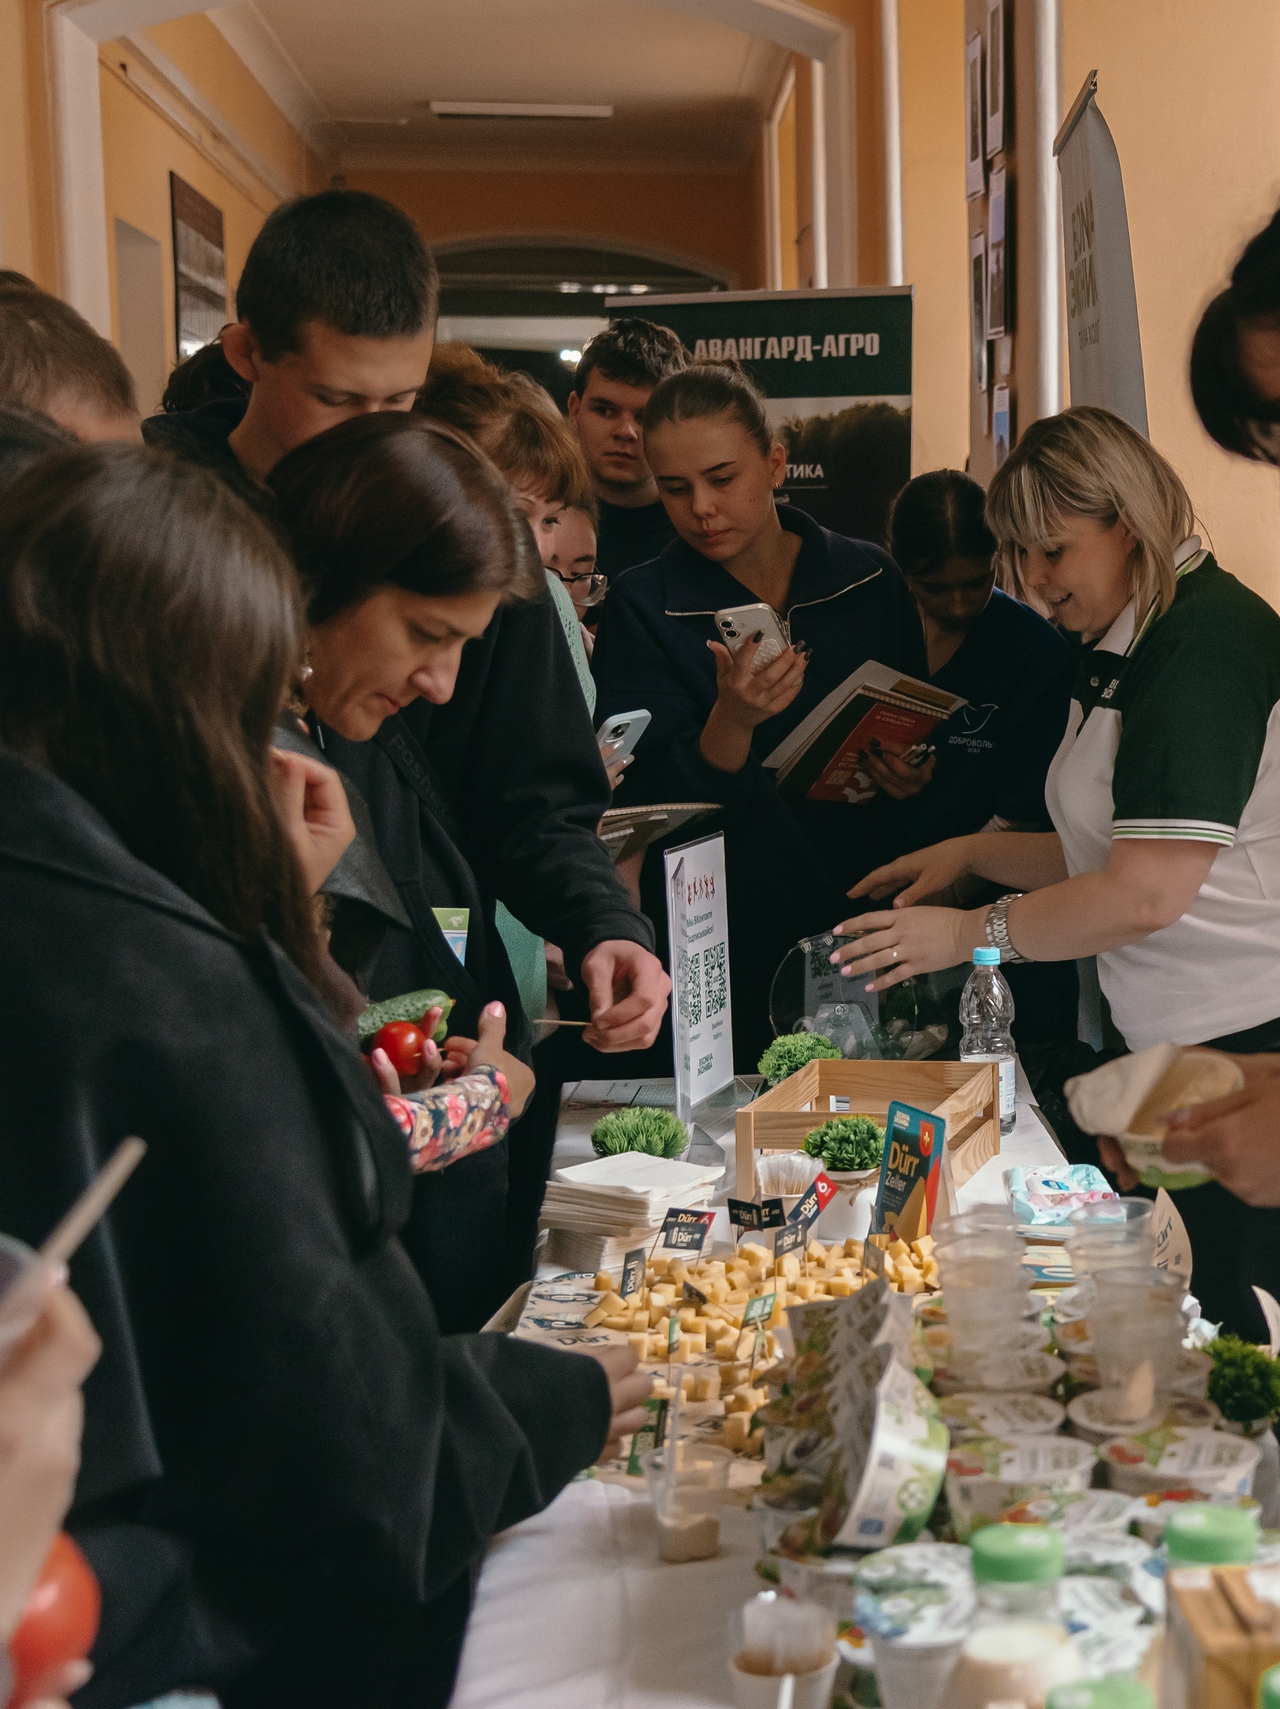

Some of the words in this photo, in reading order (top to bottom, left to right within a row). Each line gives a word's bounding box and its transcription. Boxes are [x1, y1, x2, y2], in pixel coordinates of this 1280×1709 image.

[693, 332, 880, 362] АВАНГАРД-АГРО
[784, 463, 825, 478] ТИКА
[888, 1141, 920, 1178] Dürr
[885, 1171, 907, 1193] Zeller
[800, 1193, 818, 1215] Dürr
[677, 1213, 698, 1223] Dürr
[677, 1232, 693, 1242] Dürr
